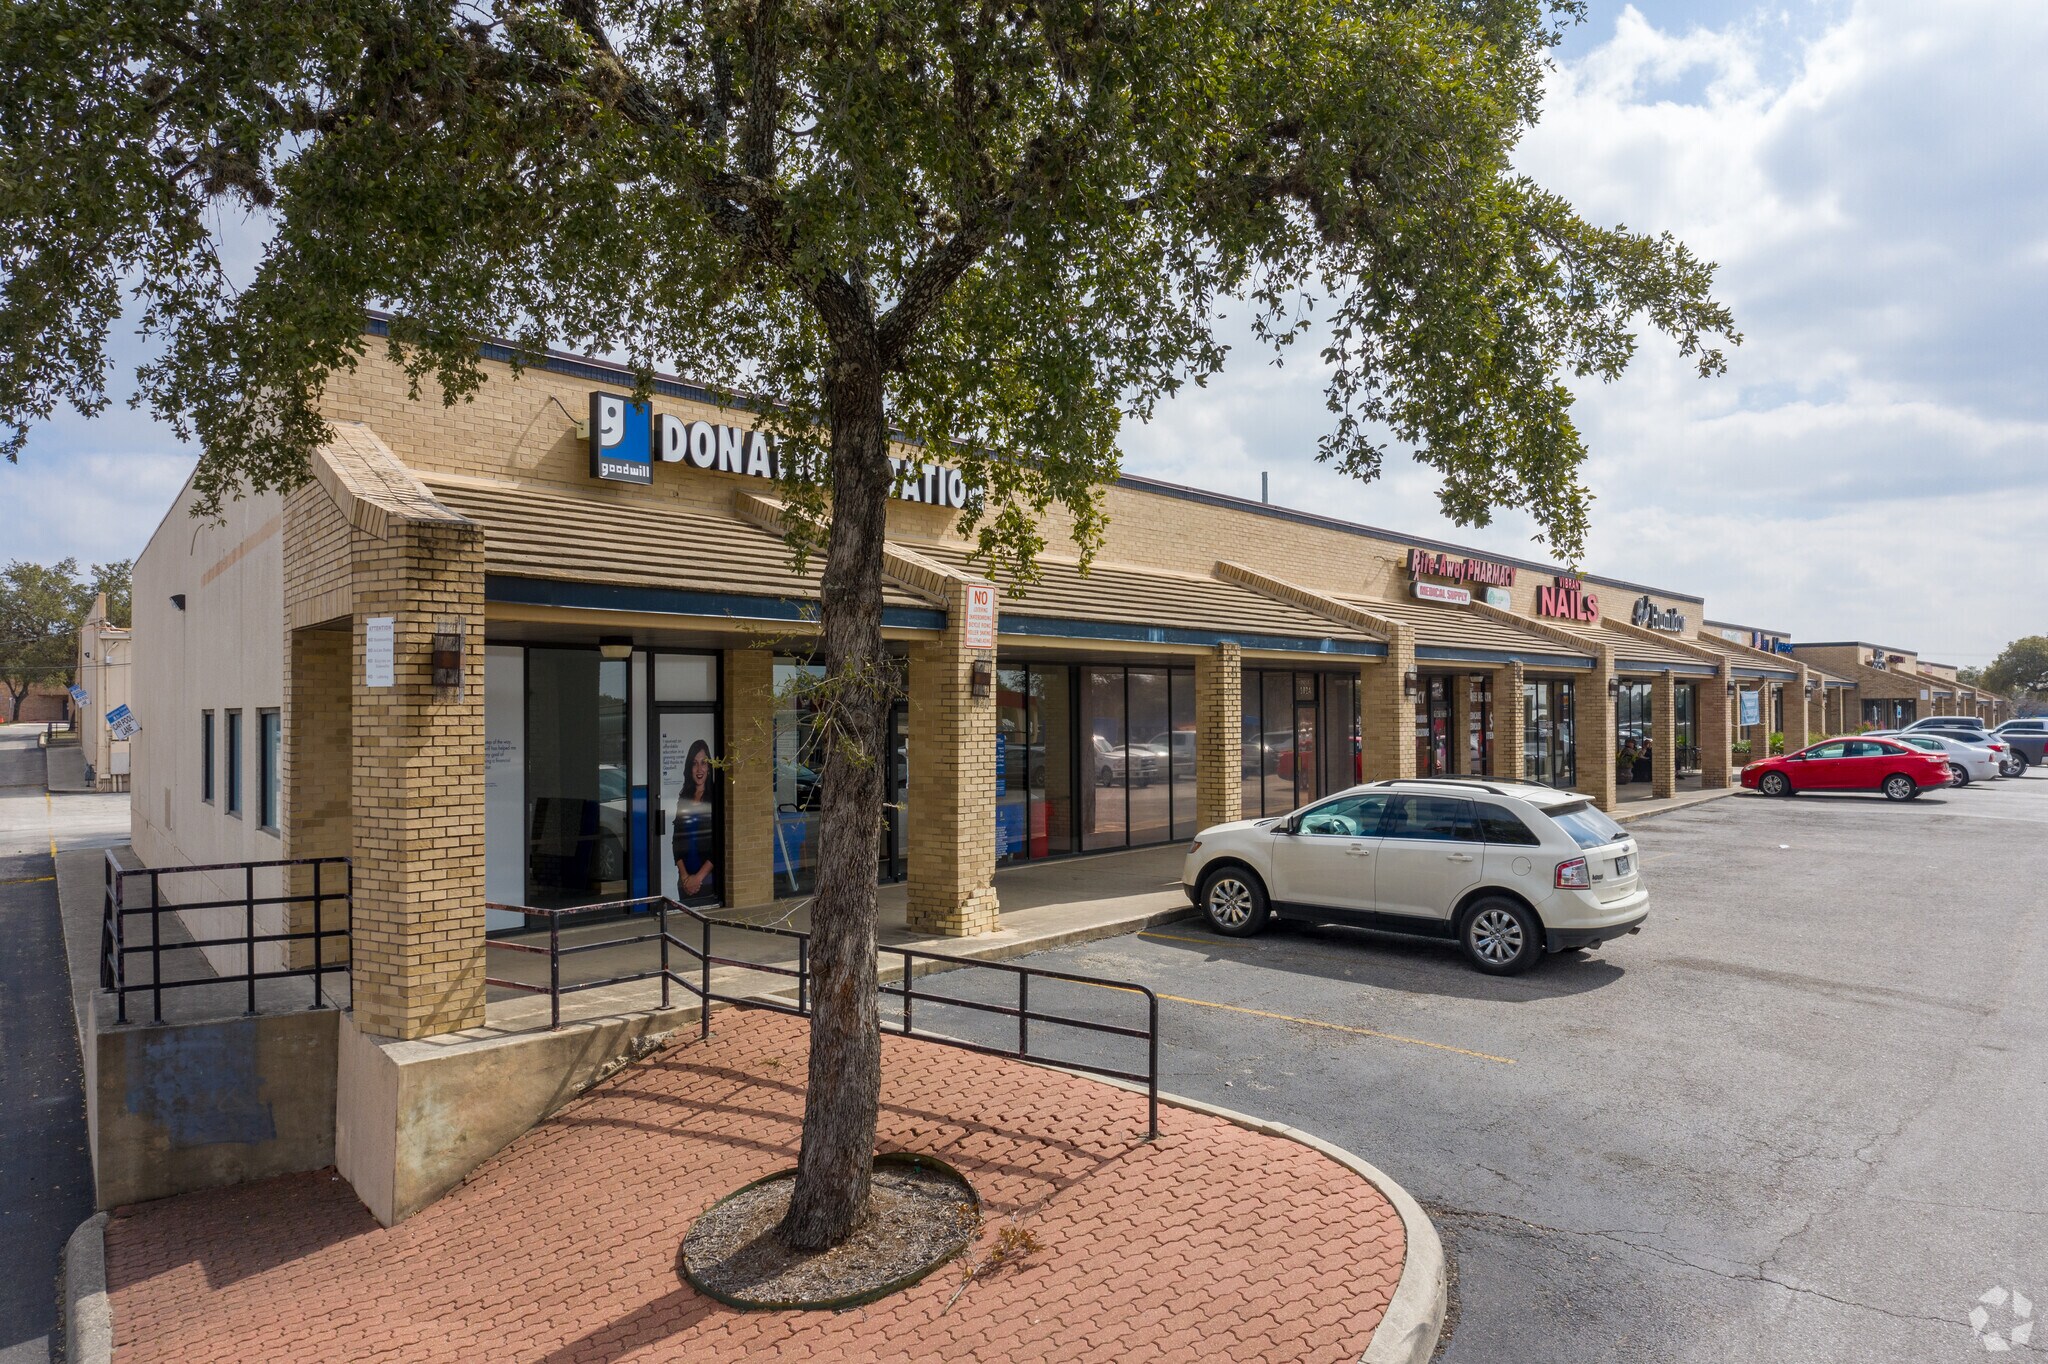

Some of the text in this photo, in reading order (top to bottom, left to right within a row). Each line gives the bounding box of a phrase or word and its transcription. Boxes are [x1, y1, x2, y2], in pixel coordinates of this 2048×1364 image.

[601, 462, 650, 477] goodwill
[1467, 559, 1517, 587] PHARMACY
[974, 590, 989, 605] NO
[1419, 585, 1468, 602] MEDICAL SUPPLY
[1541, 585, 1599, 622] NAILS
[112, 715, 134, 731] CAR POOL
[120, 724, 134, 735] LANE
